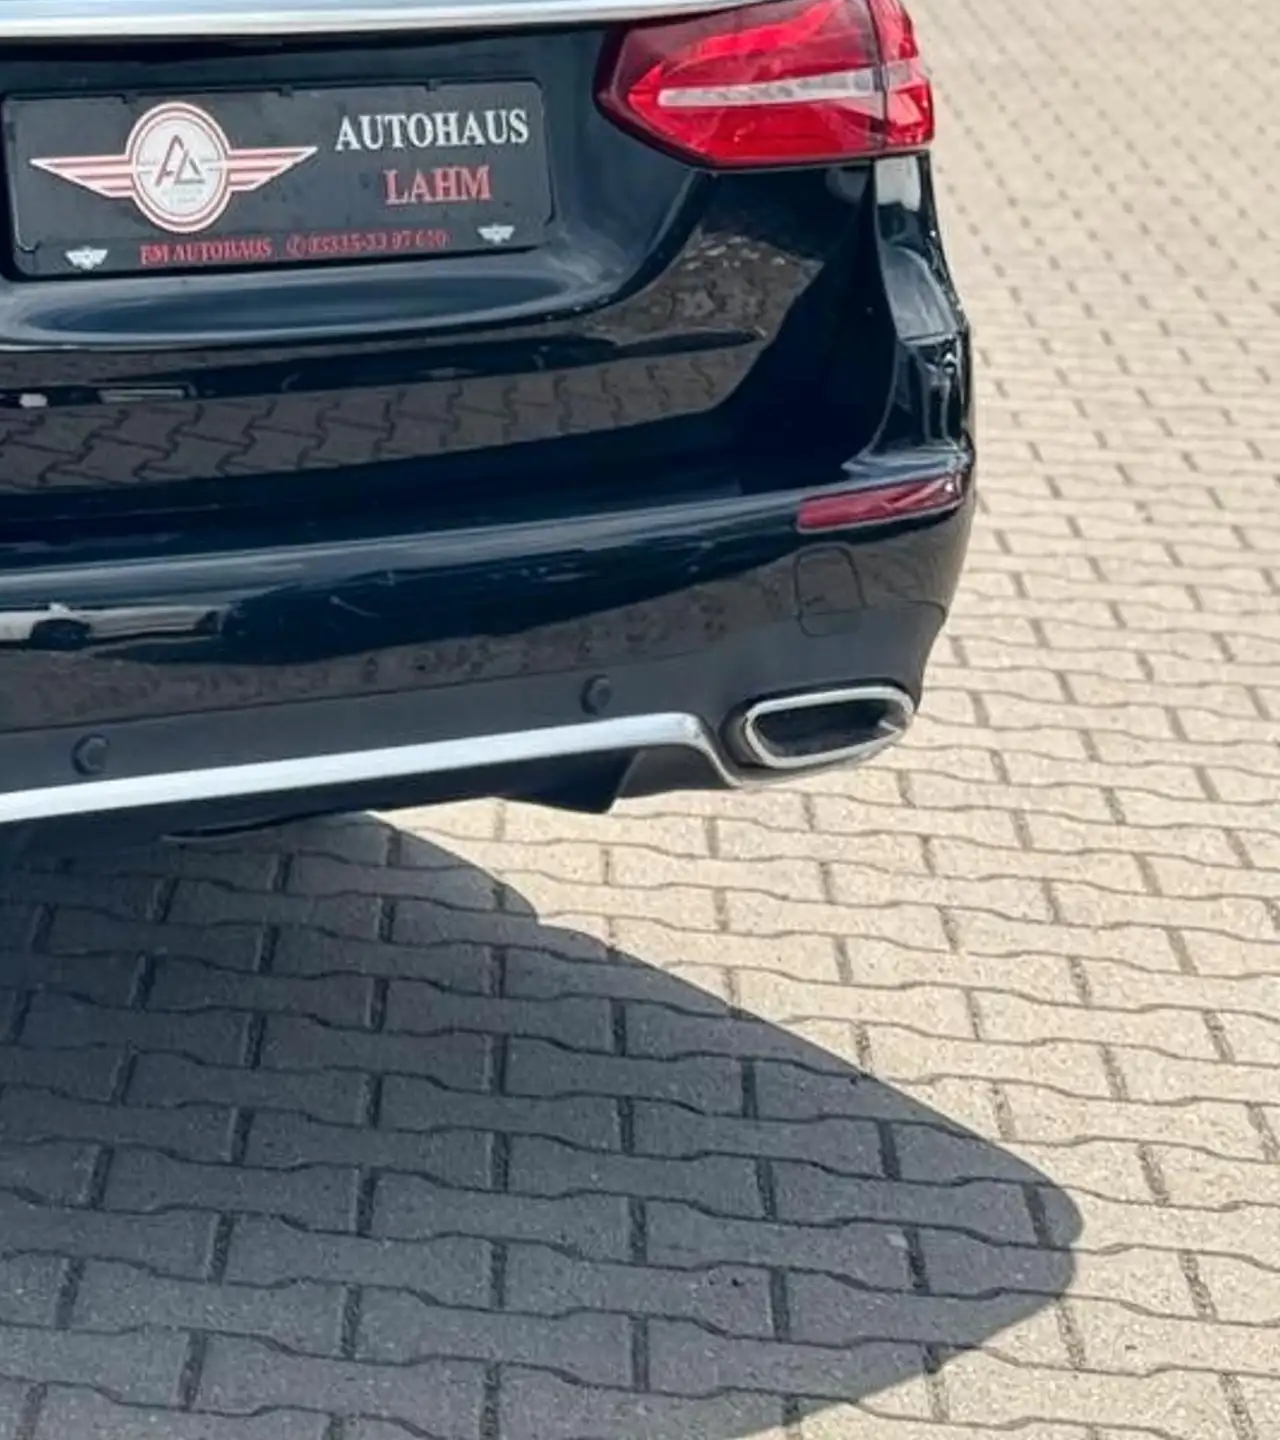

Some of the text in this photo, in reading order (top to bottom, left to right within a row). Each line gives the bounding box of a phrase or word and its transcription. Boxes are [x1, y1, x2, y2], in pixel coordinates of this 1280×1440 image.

[335, 109, 529, 151] AUTOHAUS
[384, 164, 492, 205] LAHM
[173, 234, 272, 262] AUTOHAUS
